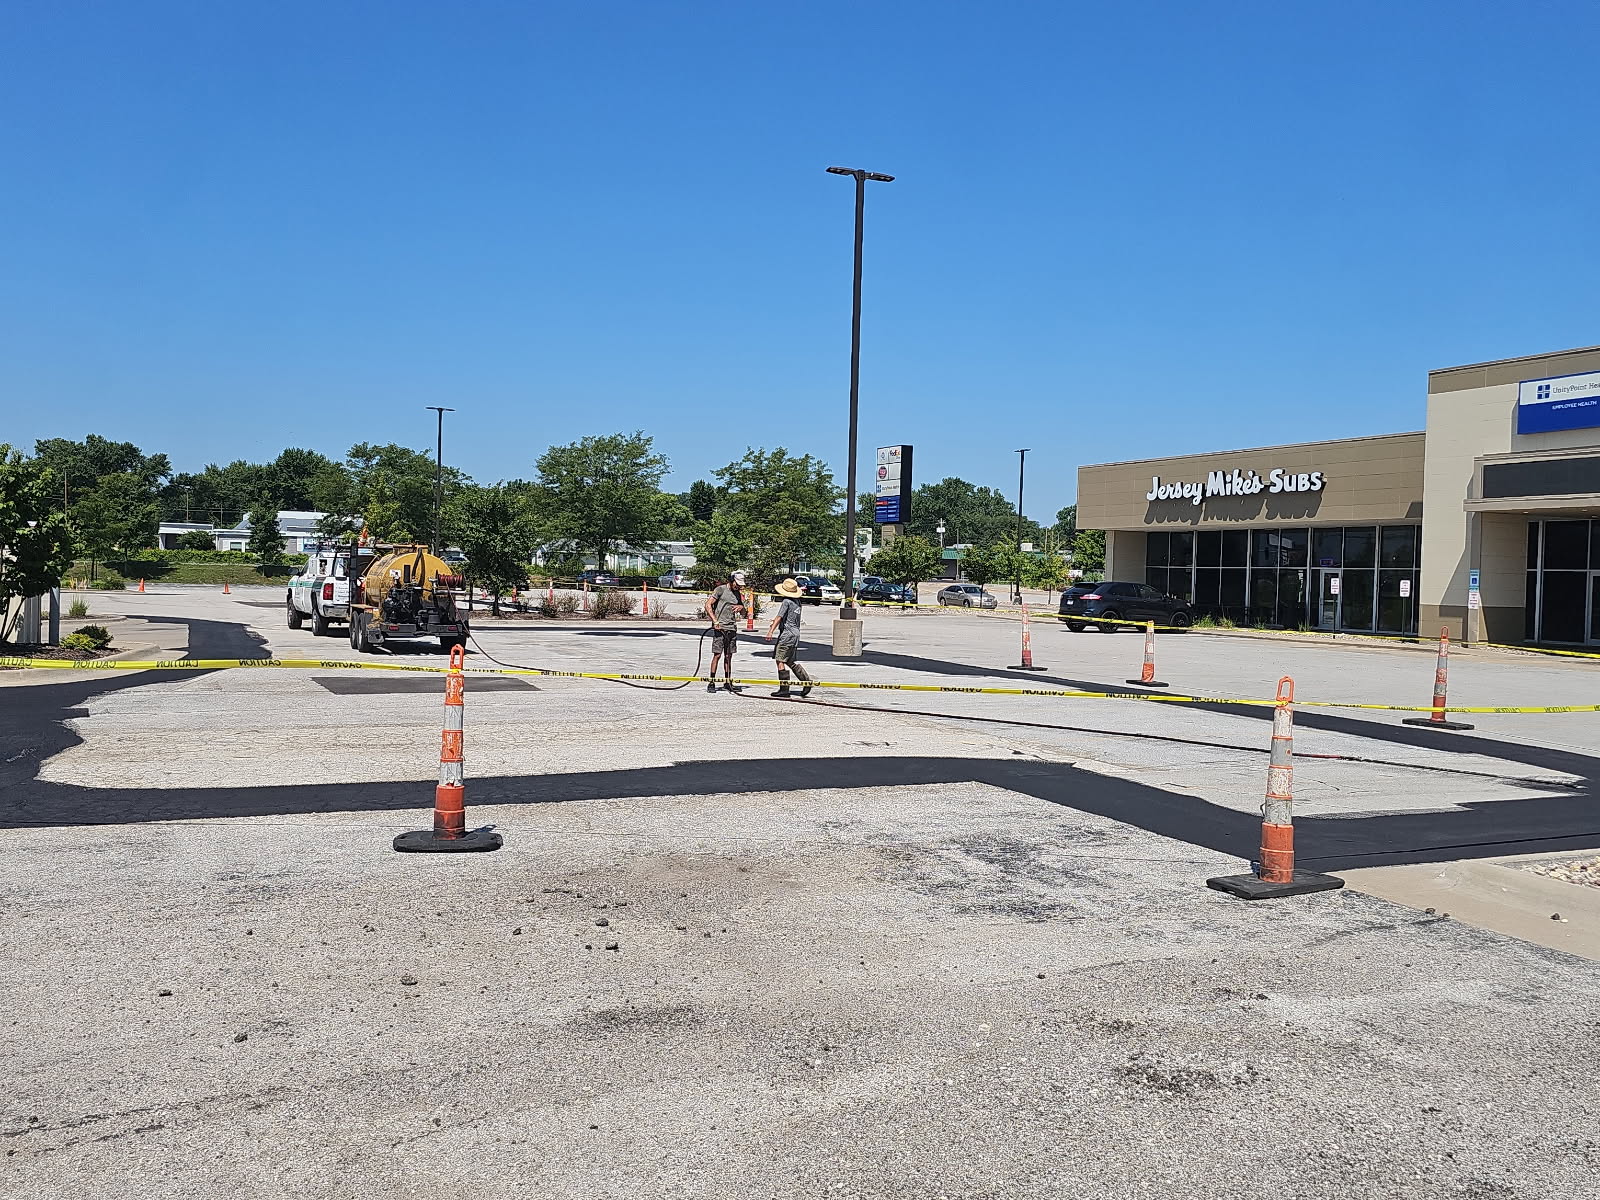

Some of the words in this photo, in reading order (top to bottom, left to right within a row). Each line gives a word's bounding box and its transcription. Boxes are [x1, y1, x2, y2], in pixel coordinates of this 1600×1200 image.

[1553, 384, 1587, 393] UnityPoint
[1552, 402, 1577, 410] EMPLOYEE
[1147, 476, 1202, 506] Jersey
[1205, 469, 1264, 497] Mike's
